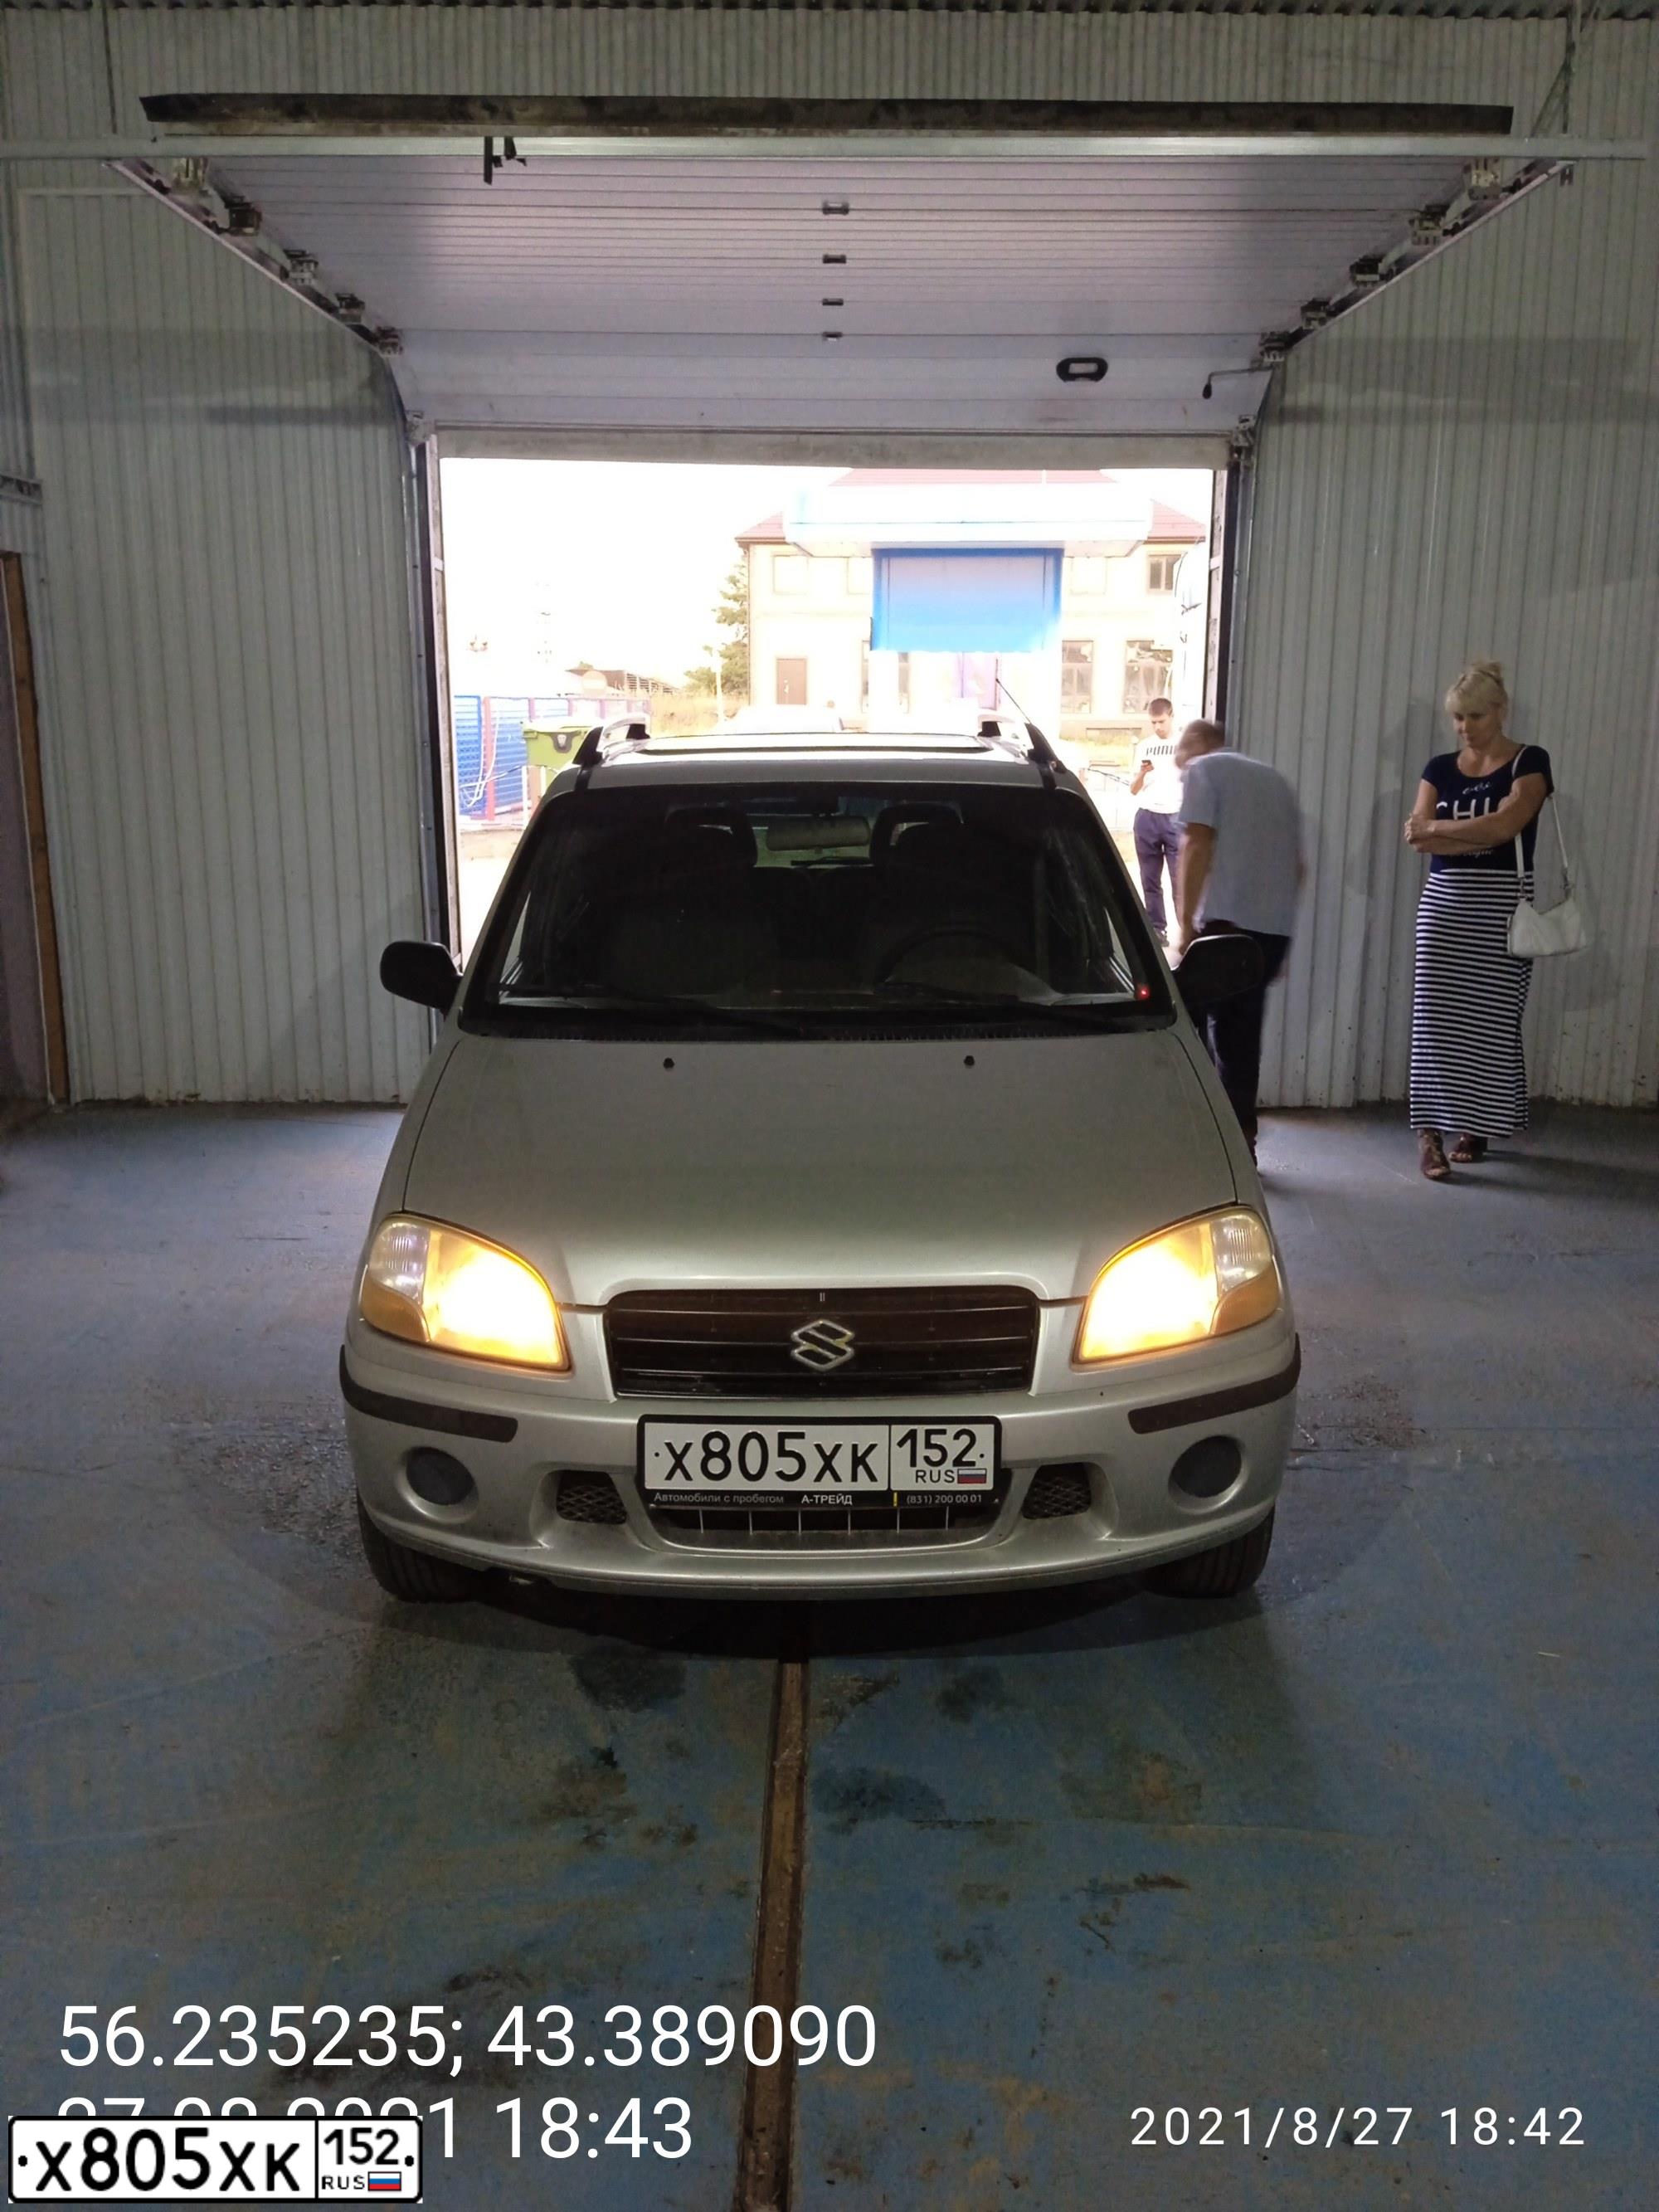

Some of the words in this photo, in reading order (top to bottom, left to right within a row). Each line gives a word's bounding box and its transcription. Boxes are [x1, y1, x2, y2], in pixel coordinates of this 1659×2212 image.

[664, 1430, 878, 1483] Х805ХК
[897, 1429, 976, 1468] 152
[915, 1469, 956, 1484] RUS
[653, 1493, 721, 1504] Автомобили
[733, 1495, 784, 1505] пробегом
[801, 1494, 853, 1506] А-ТРЕЙД
[906, 1495, 932, 1504] (831)
[934, 1494, 954, 1503] 200
[955, 1494, 969, 1503] 00
[970, 1494, 982, 1503] 01
